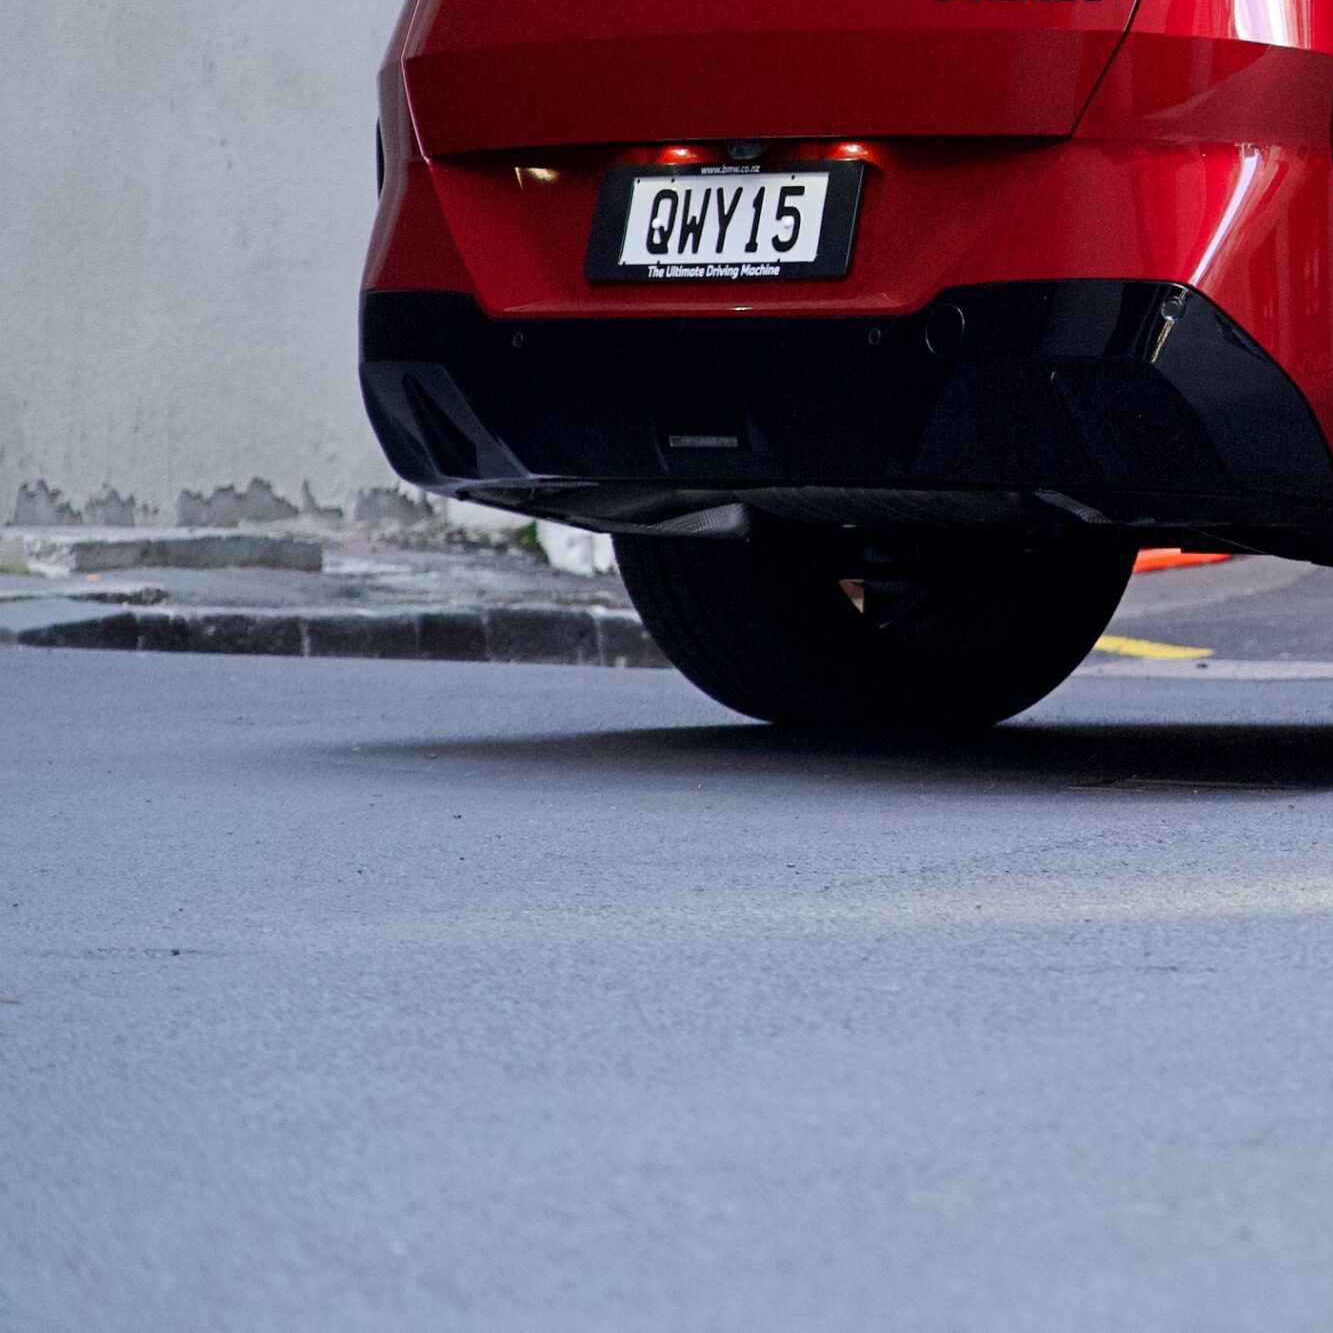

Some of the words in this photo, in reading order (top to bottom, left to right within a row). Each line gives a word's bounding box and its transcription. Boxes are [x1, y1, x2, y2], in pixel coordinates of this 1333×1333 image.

[646, 185, 806, 255] QWY15
[648, 266, 665, 277] The
[666, 266, 705, 277] Ultimate
[706, 265, 739, 279] Driving
[741, 264, 780, 276] Machine
